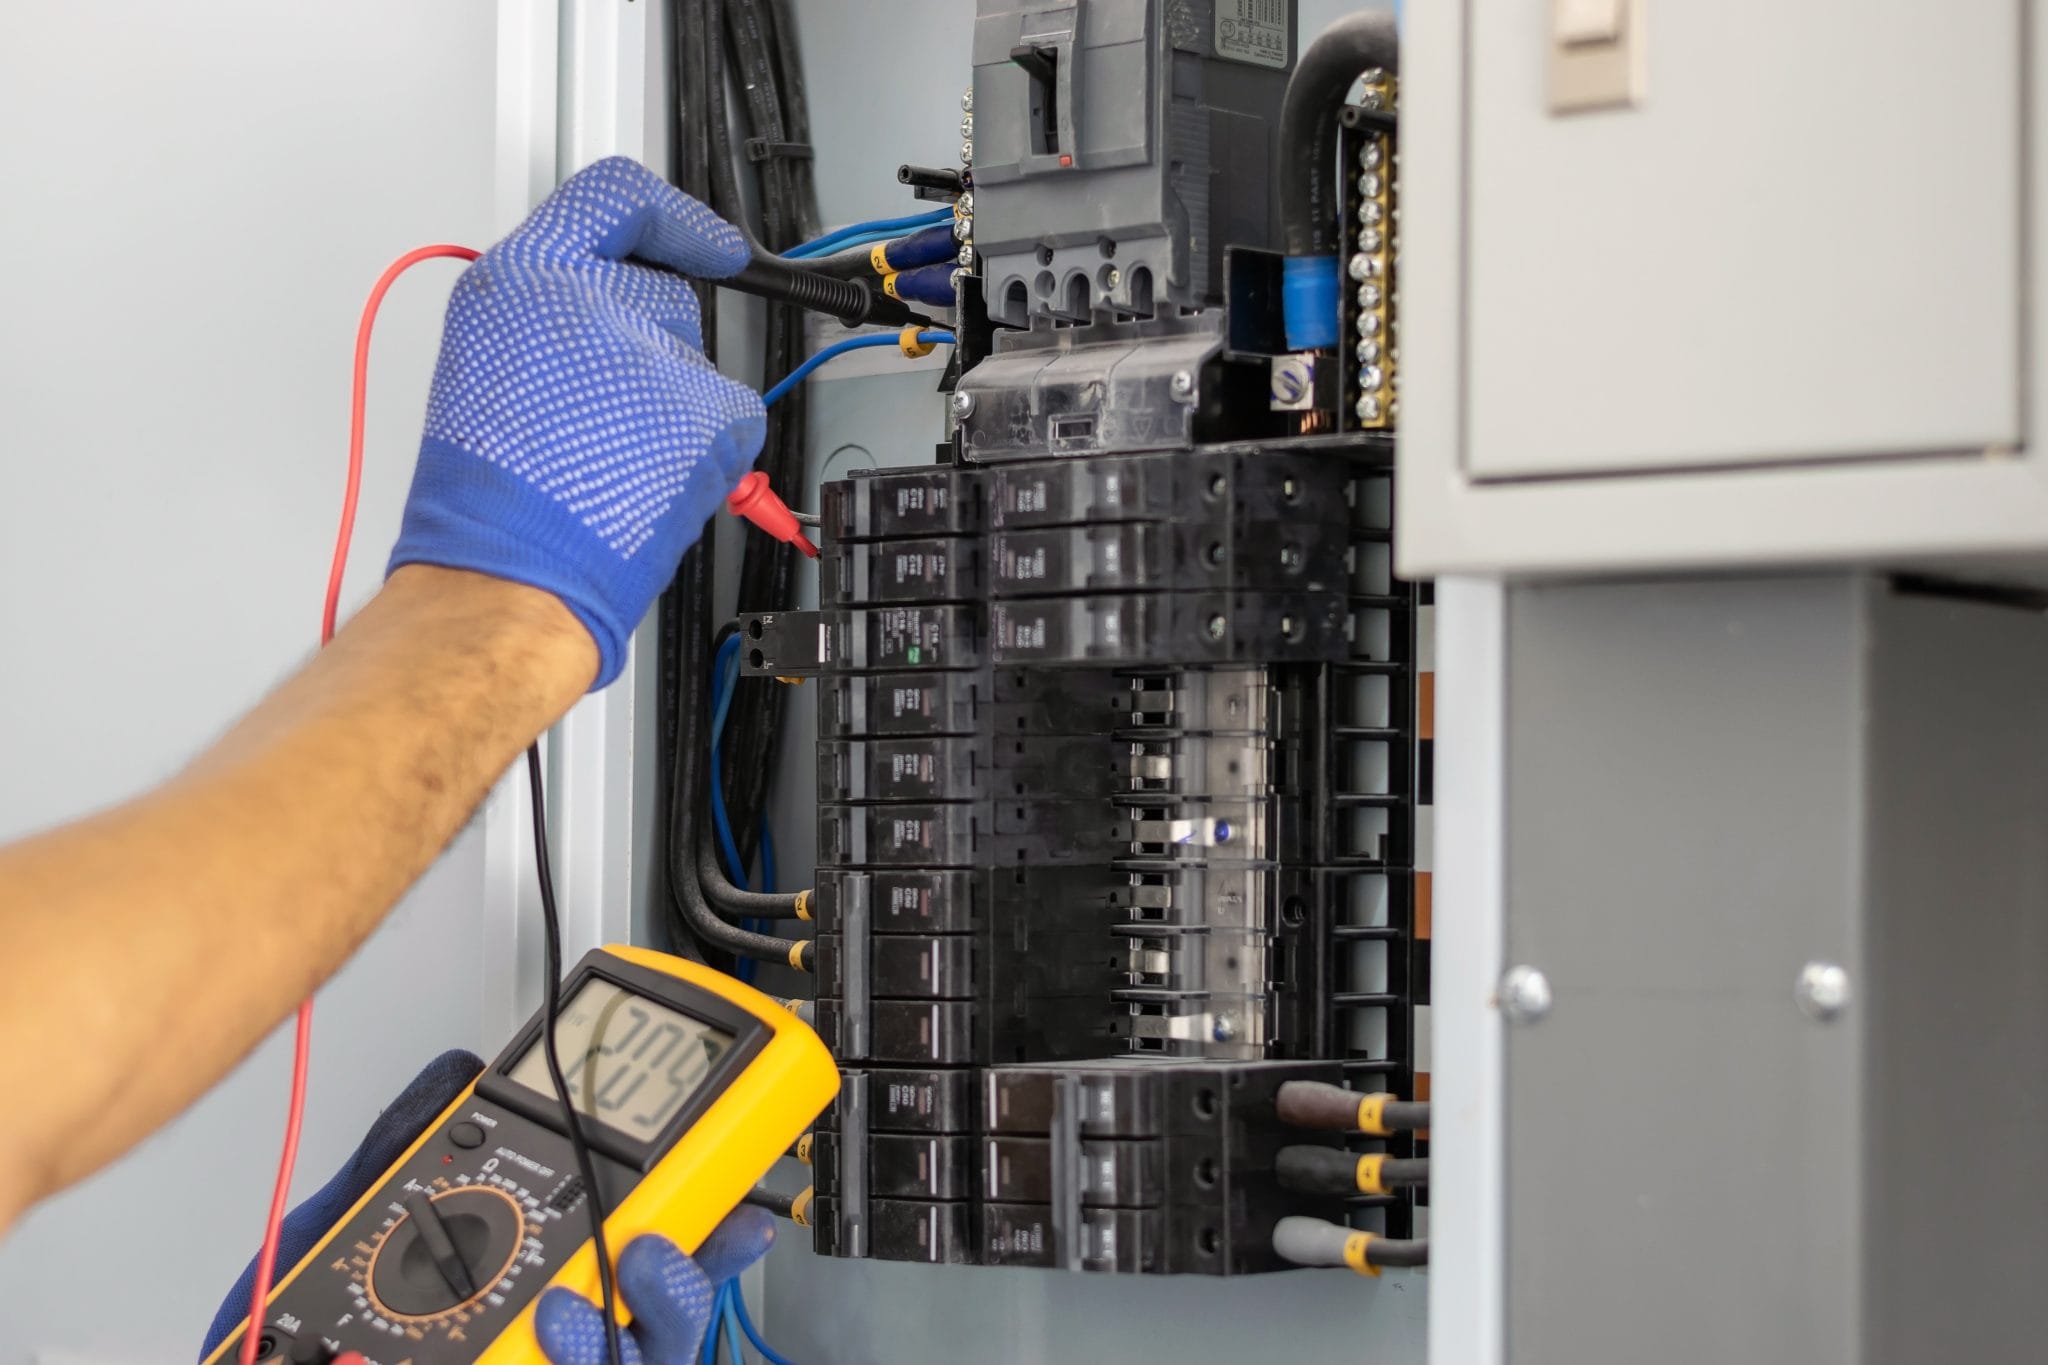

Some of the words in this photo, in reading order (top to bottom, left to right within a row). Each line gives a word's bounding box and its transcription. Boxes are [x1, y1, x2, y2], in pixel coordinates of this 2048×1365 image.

[874, 256, 883, 269] 2
[887, 282, 894, 294] 3
[766, 615, 773, 624] N
[931, 624, 940, 644] C16
[797, 897, 802, 911] 2
[469, 1111, 499, 1128] POWER
[800, 1144, 806, 1157] 3
[494, 1147, 518, 1160] AUTO
[512, 1154, 542, 1171] POWER
[536, 1165, 556, 1177] OFF
[275, 1312, 302, 1331] 20A
[335, 1313, 353, 1327] F
